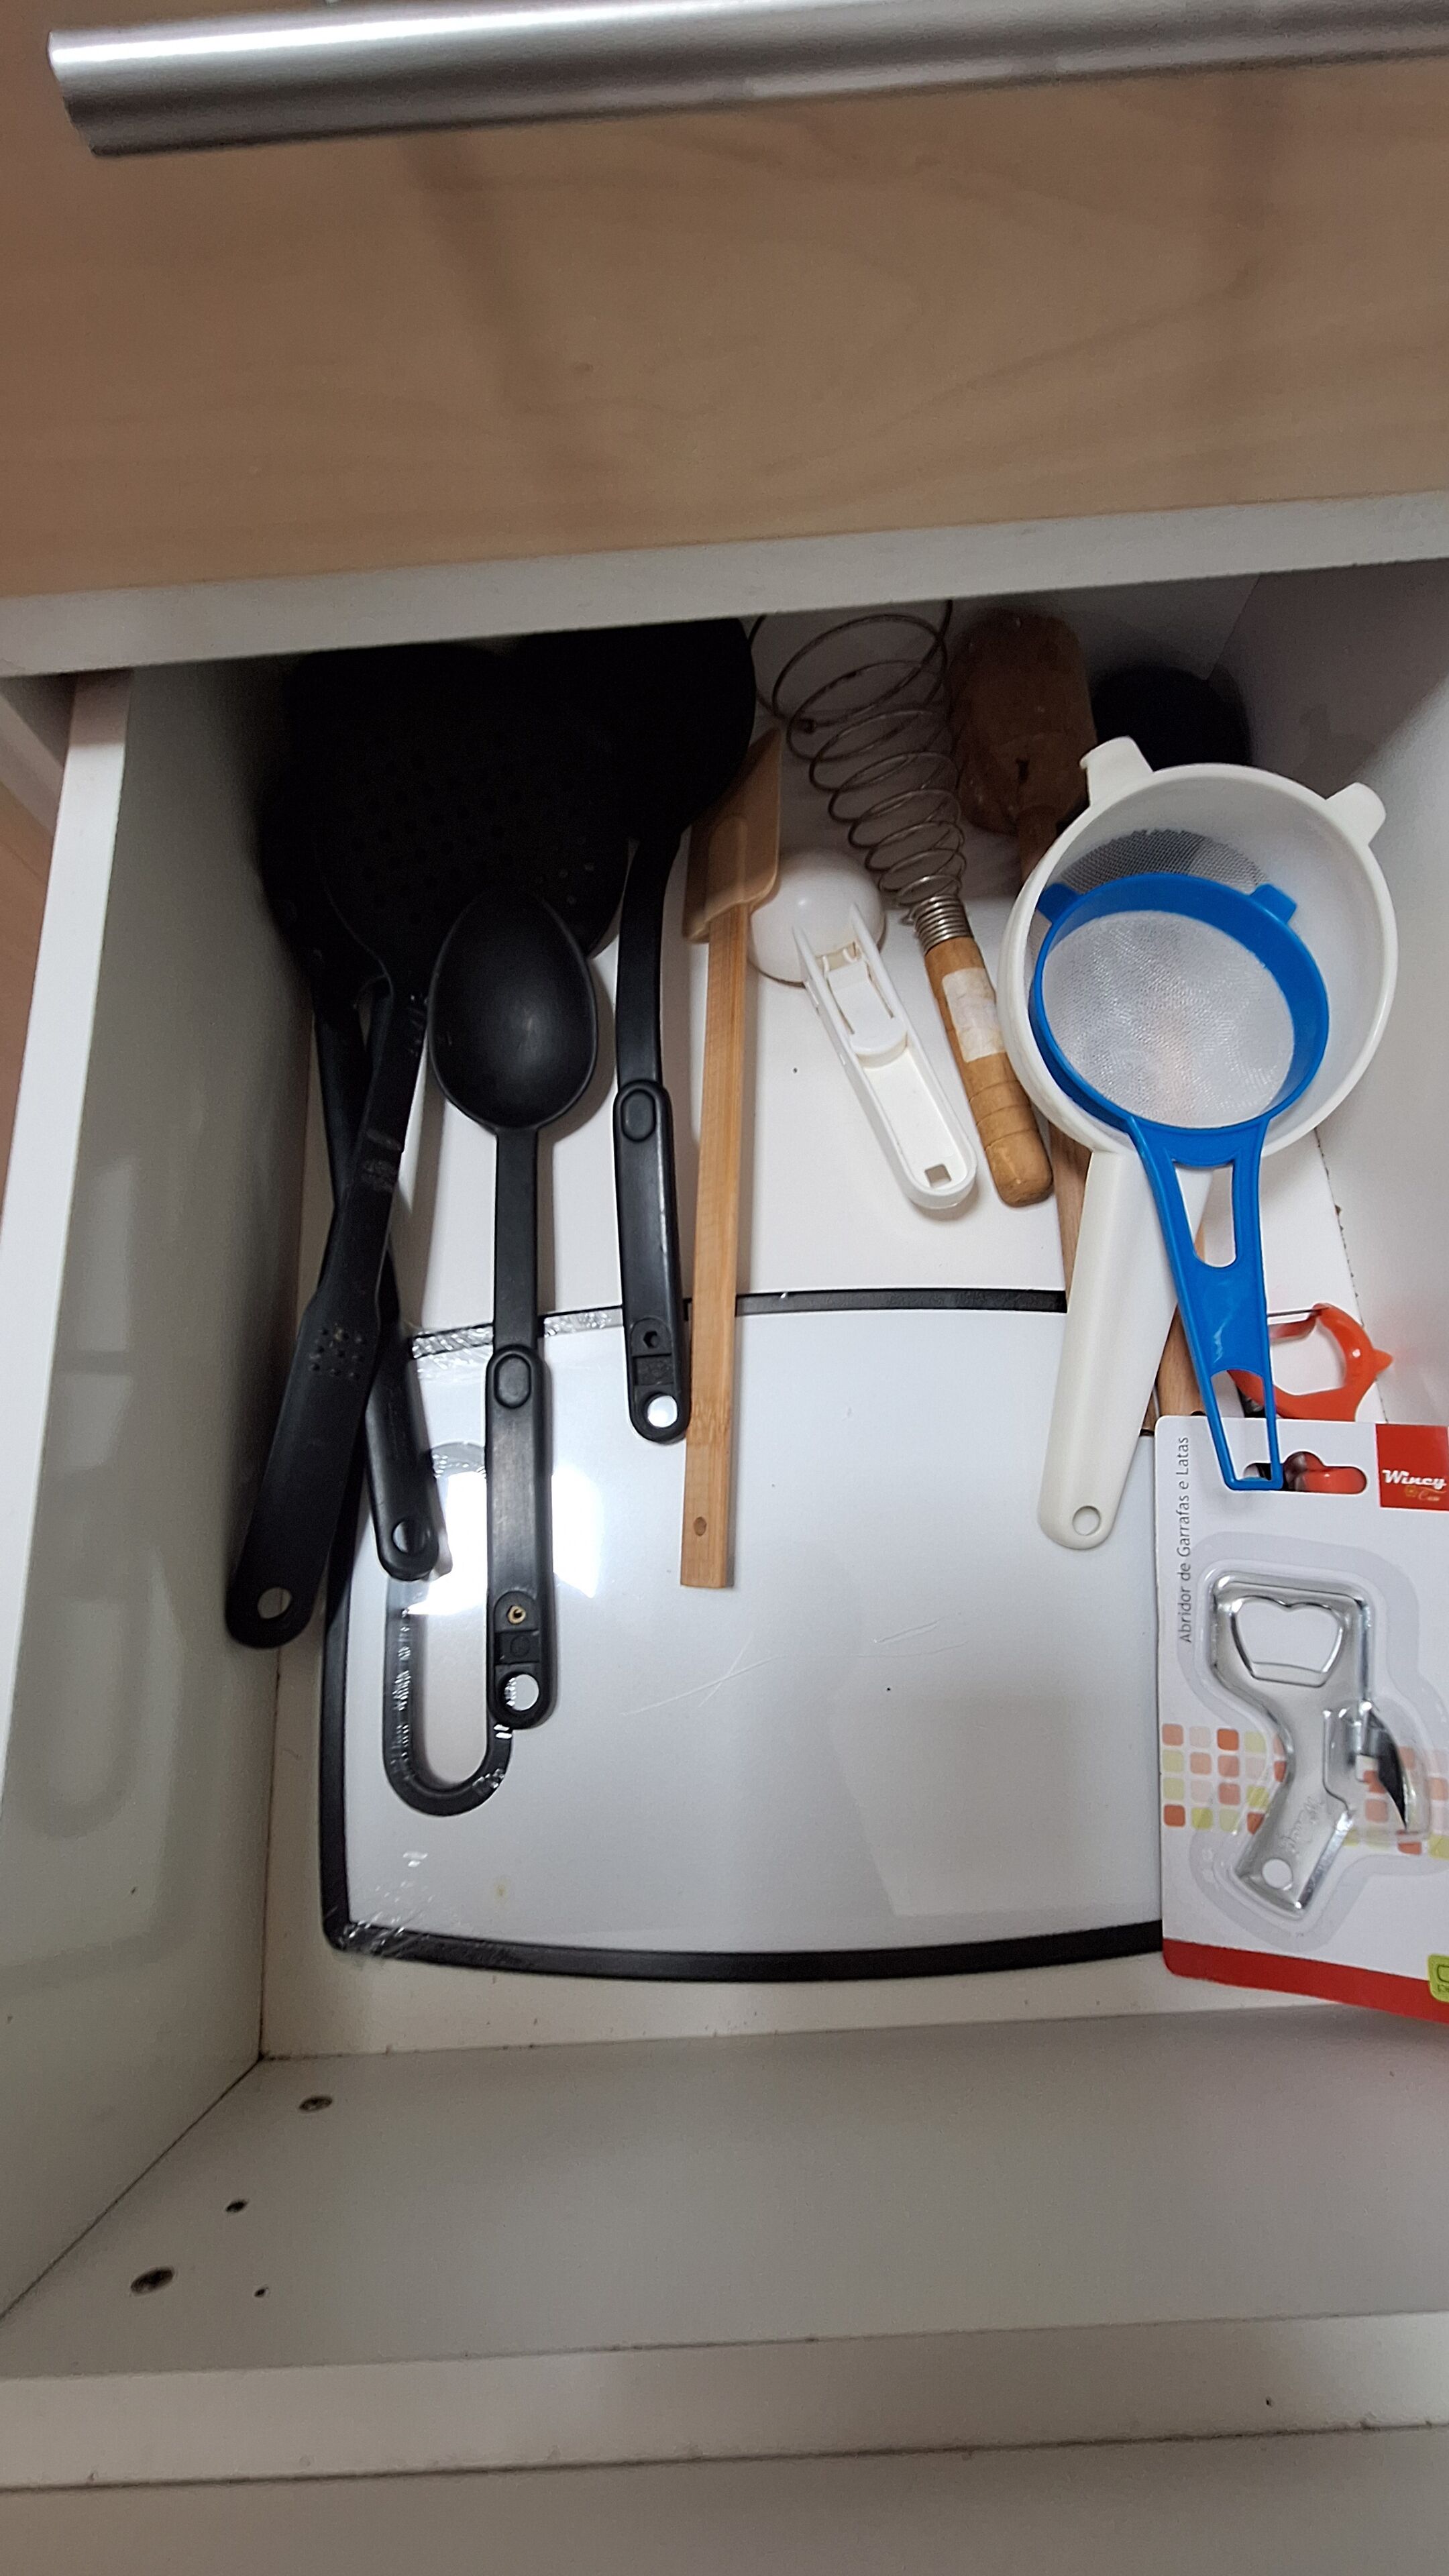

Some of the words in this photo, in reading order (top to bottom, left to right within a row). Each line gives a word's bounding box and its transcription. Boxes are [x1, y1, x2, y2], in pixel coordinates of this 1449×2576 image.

[1175, 1436, 1189, 1475] Latas
[1179, 1481, 1189, 1490] e
[1382, 1469, 1447, 1490] Wincy
[1176, 1495, 1191, 1557] Garrafas
[1177, 1562, 1191, 1581] de
[1177, 1586, 1192, 1644] Abridor
